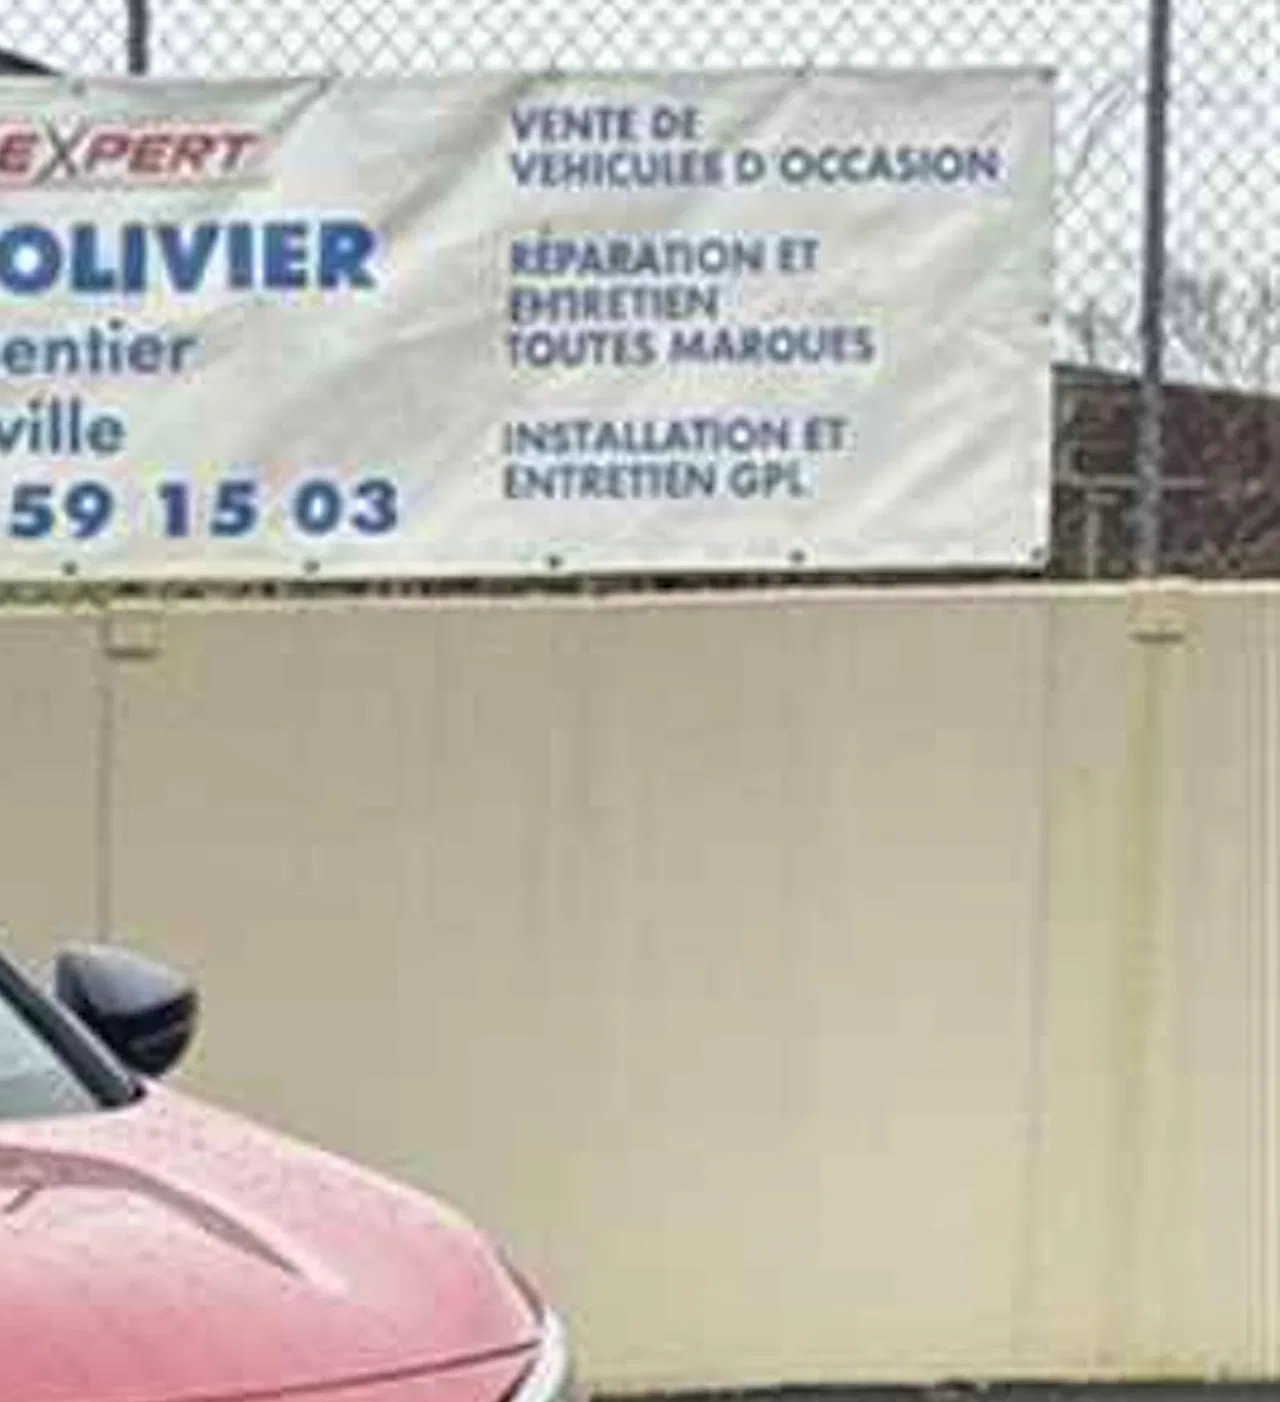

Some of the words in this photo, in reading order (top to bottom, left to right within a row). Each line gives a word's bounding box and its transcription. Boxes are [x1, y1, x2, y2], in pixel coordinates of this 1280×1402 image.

[511, 106, 636, 142] VENTE
[650, 104, 702, 140] DE
[778, 237, 820, 273] ET
[508, 330, 655, 367] TOUTES
[668, 326, 875, 364] MARQUES
[506, 419, 789, 455] INSTALLATION
[805, 416, 851, 452] ET
[505, 462, 716, 499] ENTRETIEN
[728, 460, 807, 498] GPL
[9, 481, 114, 538] 59
[158, 481, 258, 537] 15
[294, 478, 398, 535] 03
